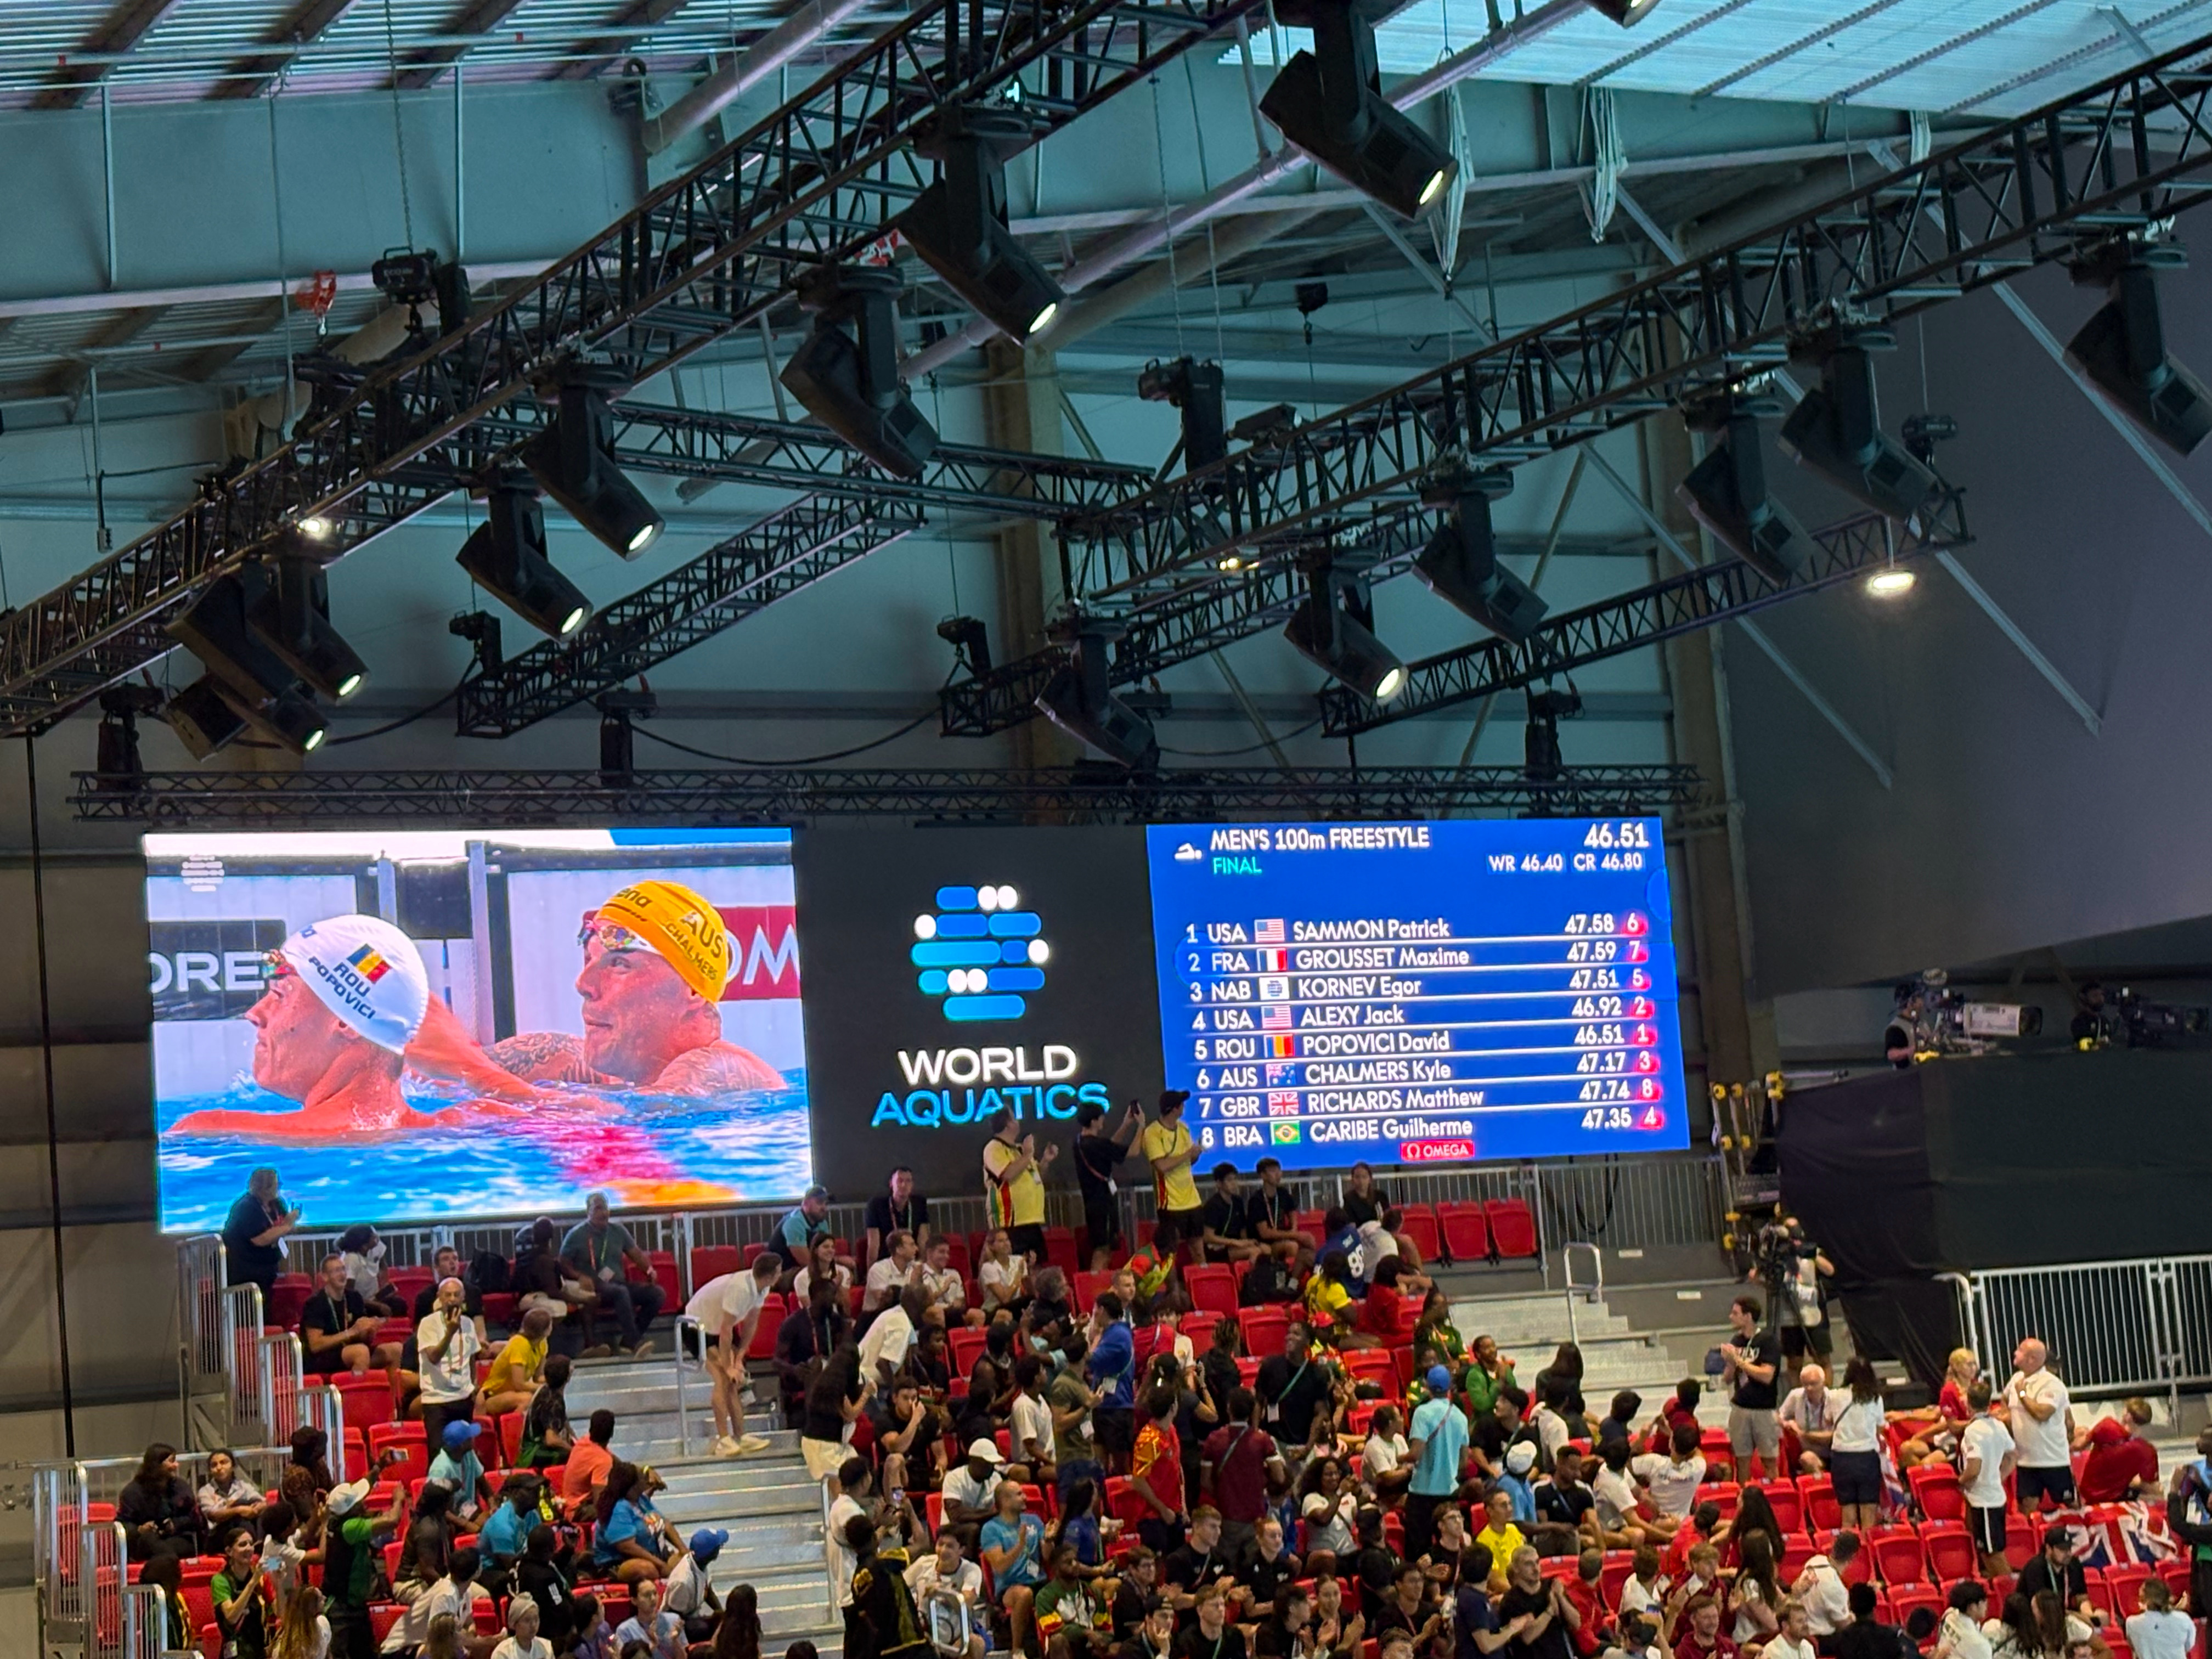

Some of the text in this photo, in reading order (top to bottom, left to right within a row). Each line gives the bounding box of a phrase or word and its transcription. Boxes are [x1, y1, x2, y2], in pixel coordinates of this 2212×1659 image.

[1210, 827, 1430, 851] MEN'S 100m FREESTYLE
[1584, 823, 1650, 848] 46.51
[1213, 857, 1262, 875] FINAL
[1488, 852, 1643, 871] WR 46.40 CR 46.80
[680, 912, 723, 958] AUS
[1187, 913, 1639, 943] 1 USA SAMMON Patrick 47.58 6
[1188, 940, 1640, 972] 2 FRA GROUSSET Maxime 47.59 7
[308, 956, 376, 1019] POPOVICI
[333, 962, 370, 997] ROU
[1189, 968, 1643, 1001] 3 NAB KORNEV Egor 47.51 5
[1193, 996, 1646, 1030] 4 USA ALEXY Jack 46.92 2
[1194, 1023, 1649, 1060] 5 ROU POPOVICI David 46.51 1
[898, 1045, 1077, 1085] WORLD
[1198, 1051, 1651, 1088] 6 AUS CHALMERS Kyle 47.17 3
[871, 1082, 1110, 1128] AQUATICS
[1199, 1078, 1653, 1117] 7 GBR RICHARDS Matthew 47.74 8
[1201, 1106, 1656, 1147] 8 BRA CARIBE Guilherme 47.35 4
[1423, 1143, 1469, 1158] OMEGA
